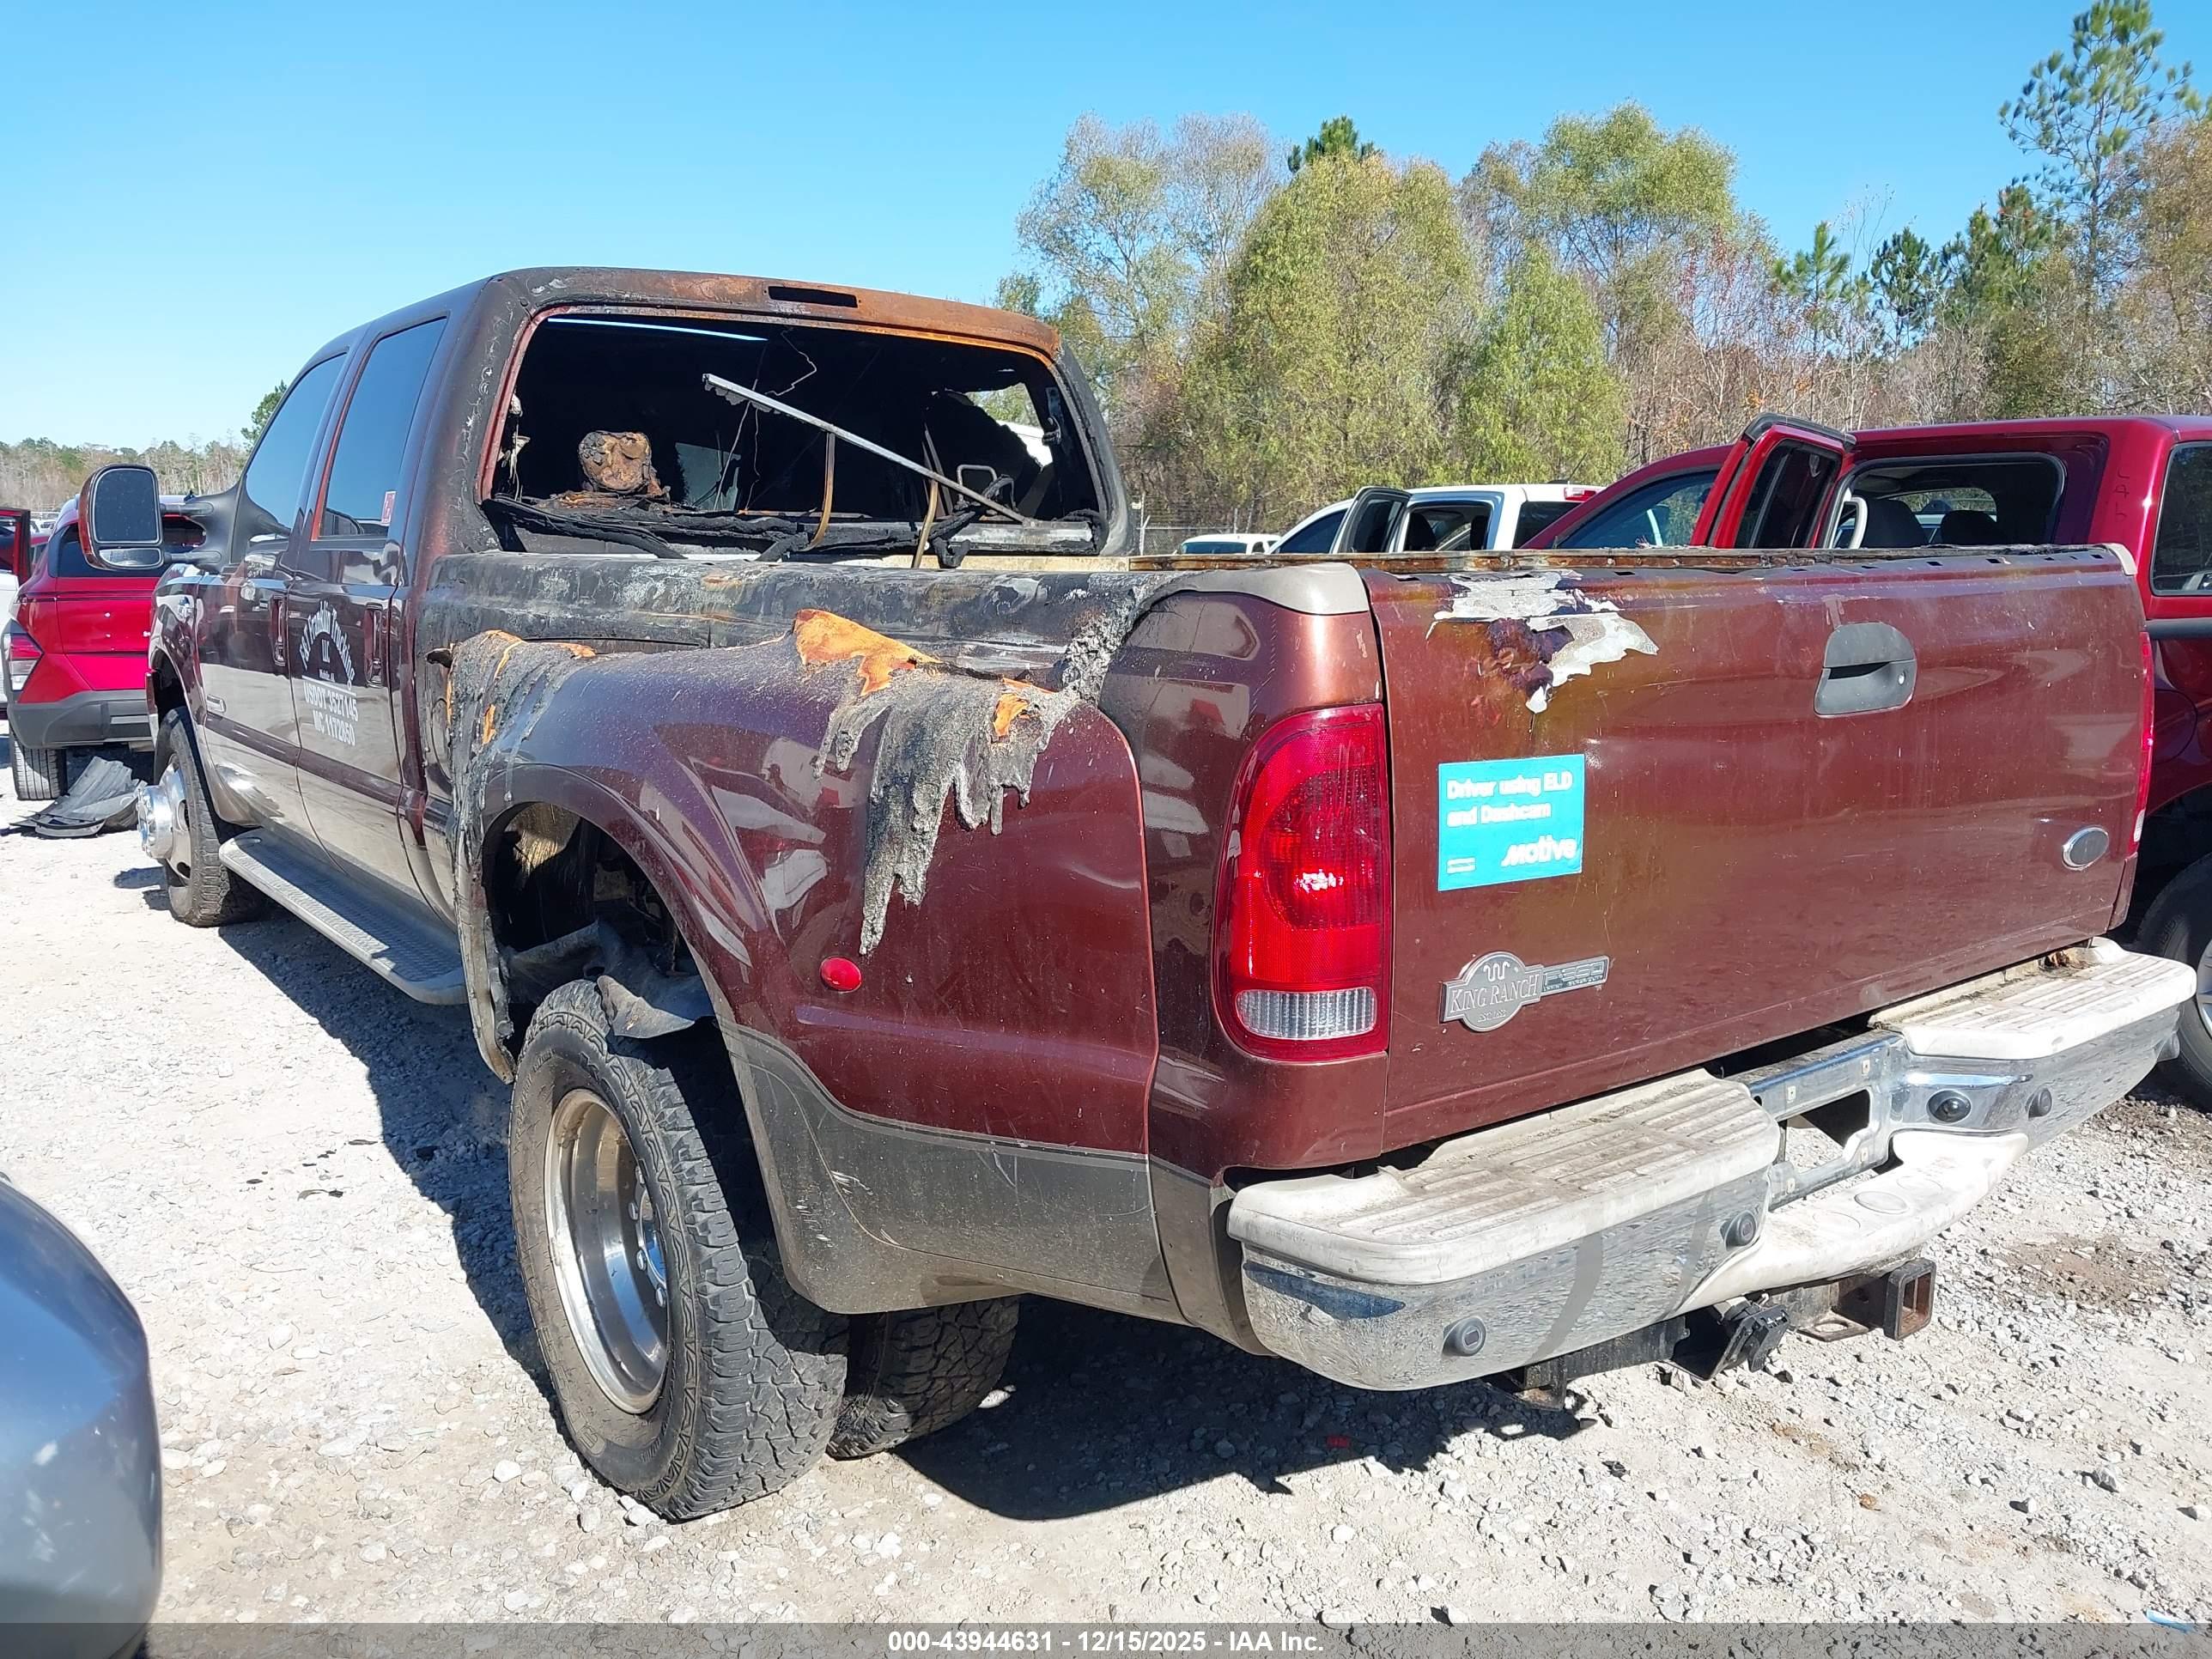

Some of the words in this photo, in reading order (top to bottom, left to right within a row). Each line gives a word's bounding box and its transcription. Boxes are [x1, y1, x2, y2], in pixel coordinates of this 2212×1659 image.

[307, 600, 331, 645] Franklin
[331, 608, 356, 691] Trucking
[321, 638, 331, 664] LLC
[303, 681, 327, 710] USDOT
[327, 690, 358, 722] 3527145
[313, 709, 325, 734] MC
[1447, 778, 1498, 799] Driver
[1498, 775, 1542, 797] using
[1543, 770, 1573, 792] ELD
[1447, 805, 1478, 827] and
[1480, 803, 1552, 824] Dashcam
[1449, 987, 1487, 1013] KING
[1490, 973, 1540, 1006] RANCH
